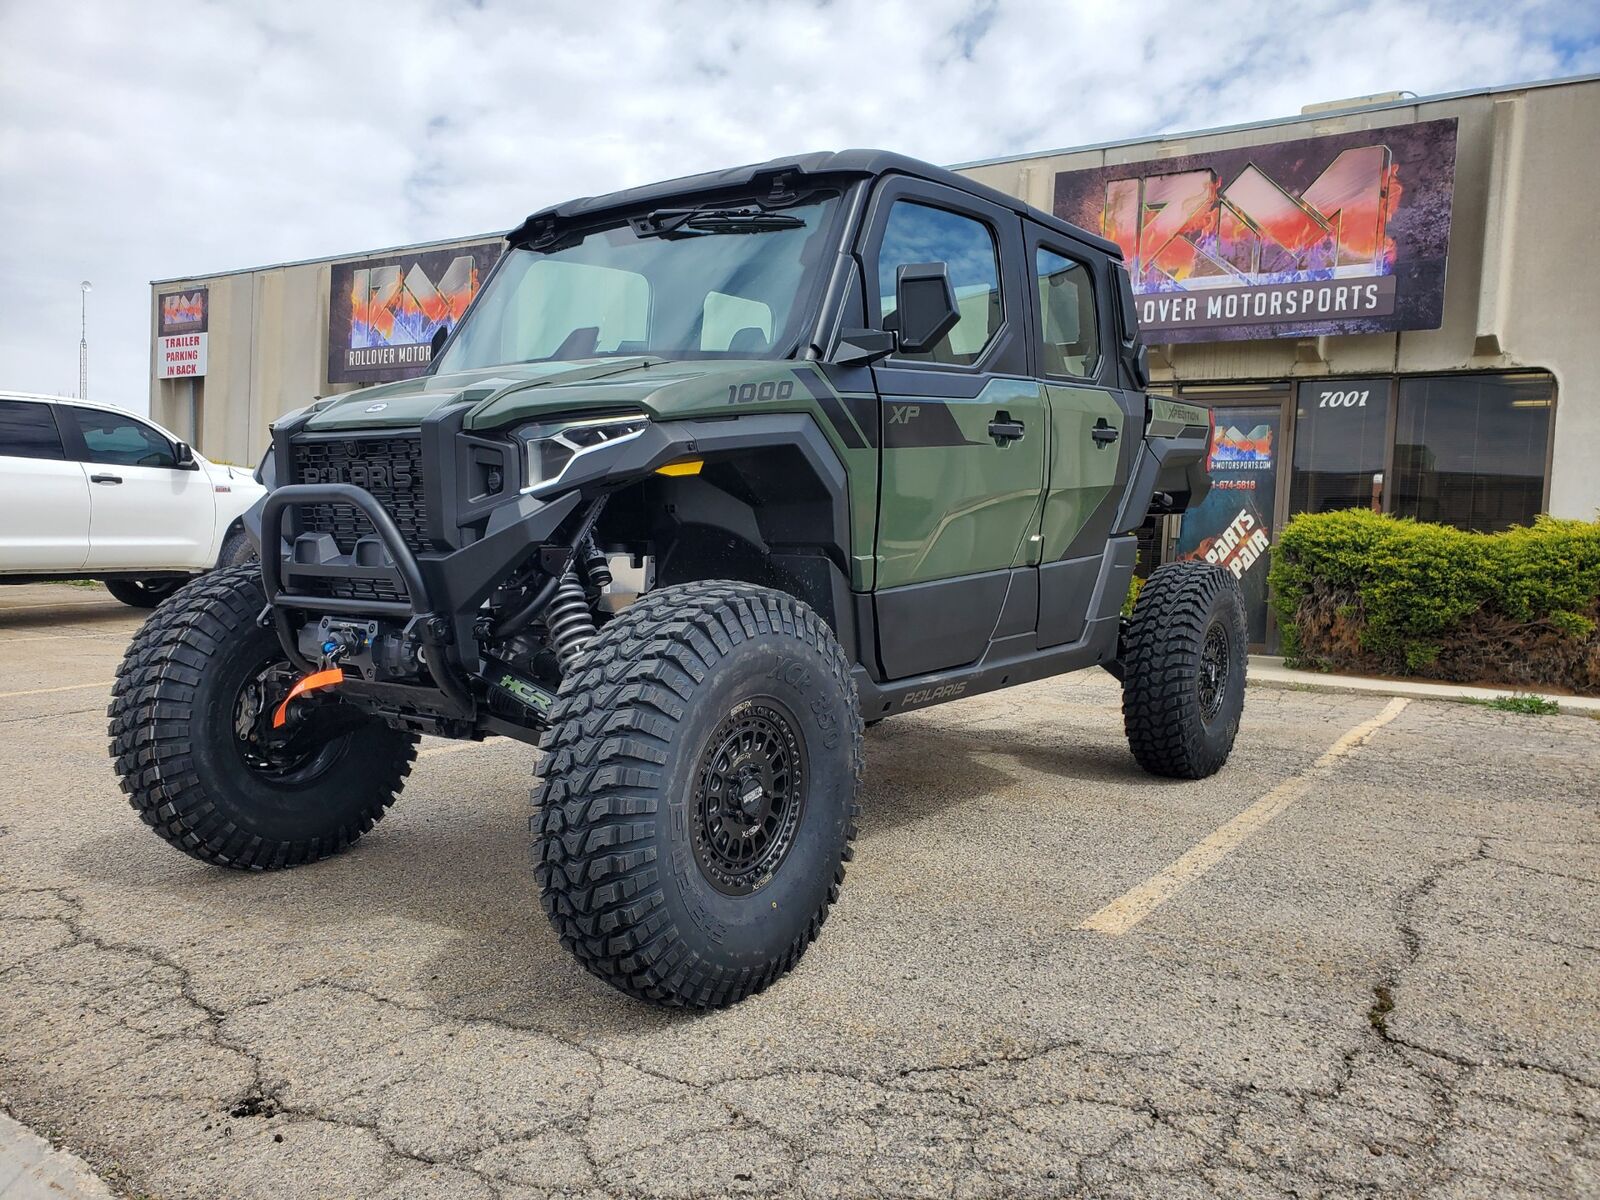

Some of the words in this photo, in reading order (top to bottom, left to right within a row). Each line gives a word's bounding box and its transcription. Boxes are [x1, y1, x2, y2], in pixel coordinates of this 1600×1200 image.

[1207, 284, 1378, 319] MOTORSPORTS
[165, 336, 200, 348] TRAILER
[166, 351, 198, 362] PARKING
[349, 348, 395, 366] ROLLOVER
[167, 366, 175, 376] IN
[176, 364, 196, 375] BACK
[728, 381, 793, 404] 1000
[1319, 390, 1369, 408] 7001
[888, 406, 920, 424] XP
[303, 464, 412, 488] POLARIS
[1204, 508, 1255, 564] PARTS
[500, 674, 552, 711] HCR
[902, 682, 967, 706] POLARIS
